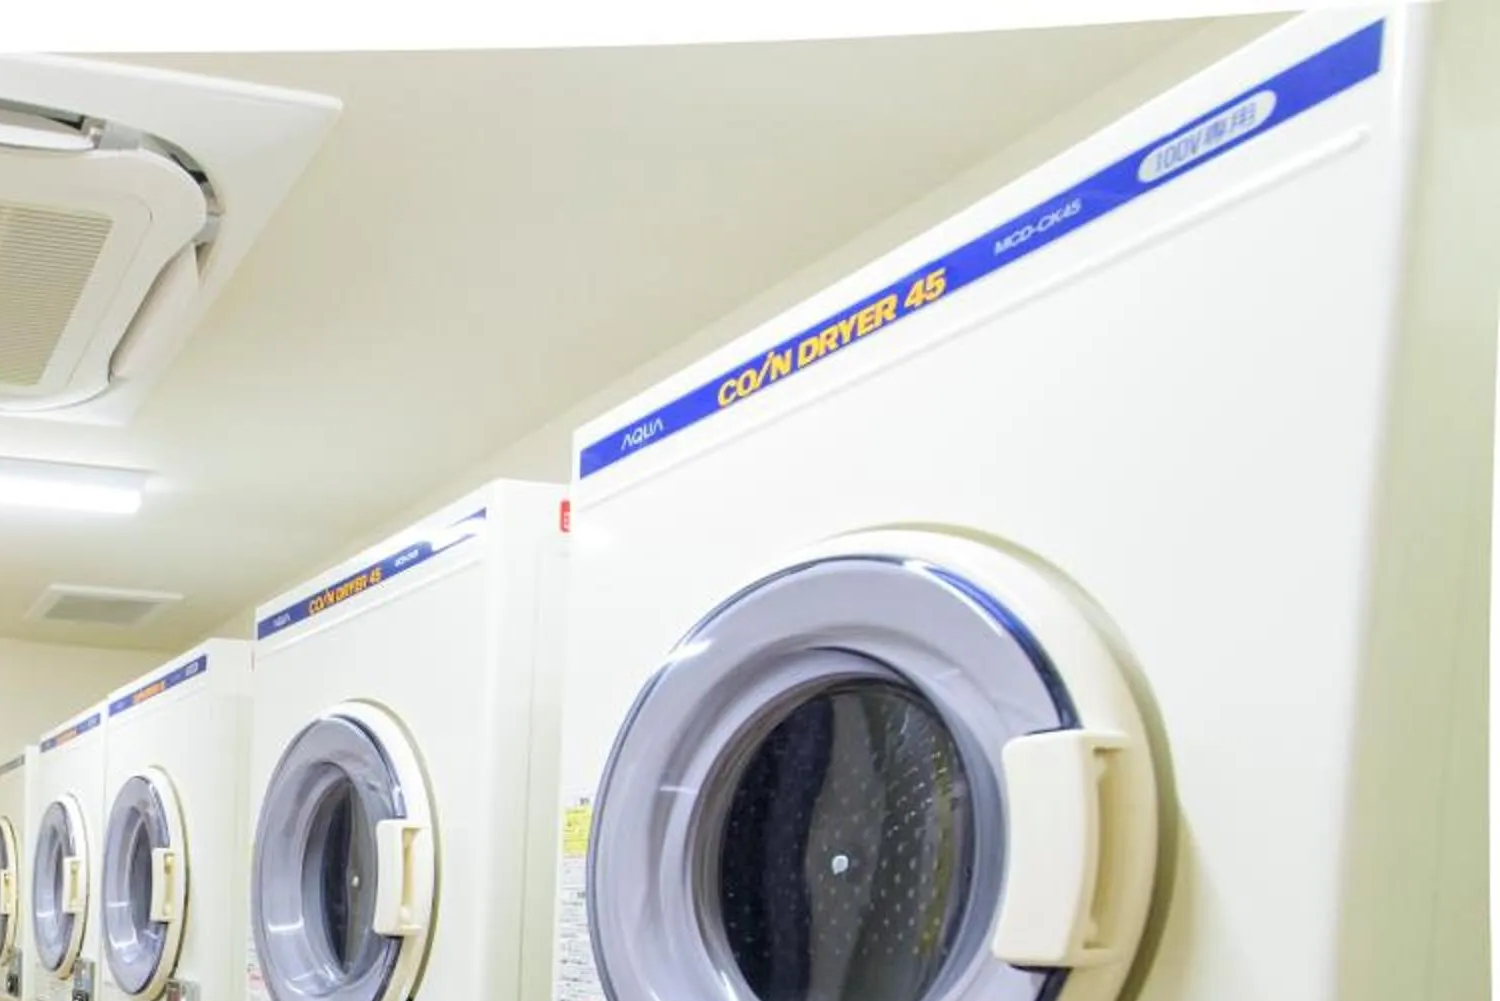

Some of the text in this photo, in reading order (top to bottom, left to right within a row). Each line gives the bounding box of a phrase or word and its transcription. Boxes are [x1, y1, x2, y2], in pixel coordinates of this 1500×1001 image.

[994, 198, 1081, 255] MCD-CK45
[717, 267, 947, 408] COIN DRYER 45
[620, 416, 664, 451] AQUA
